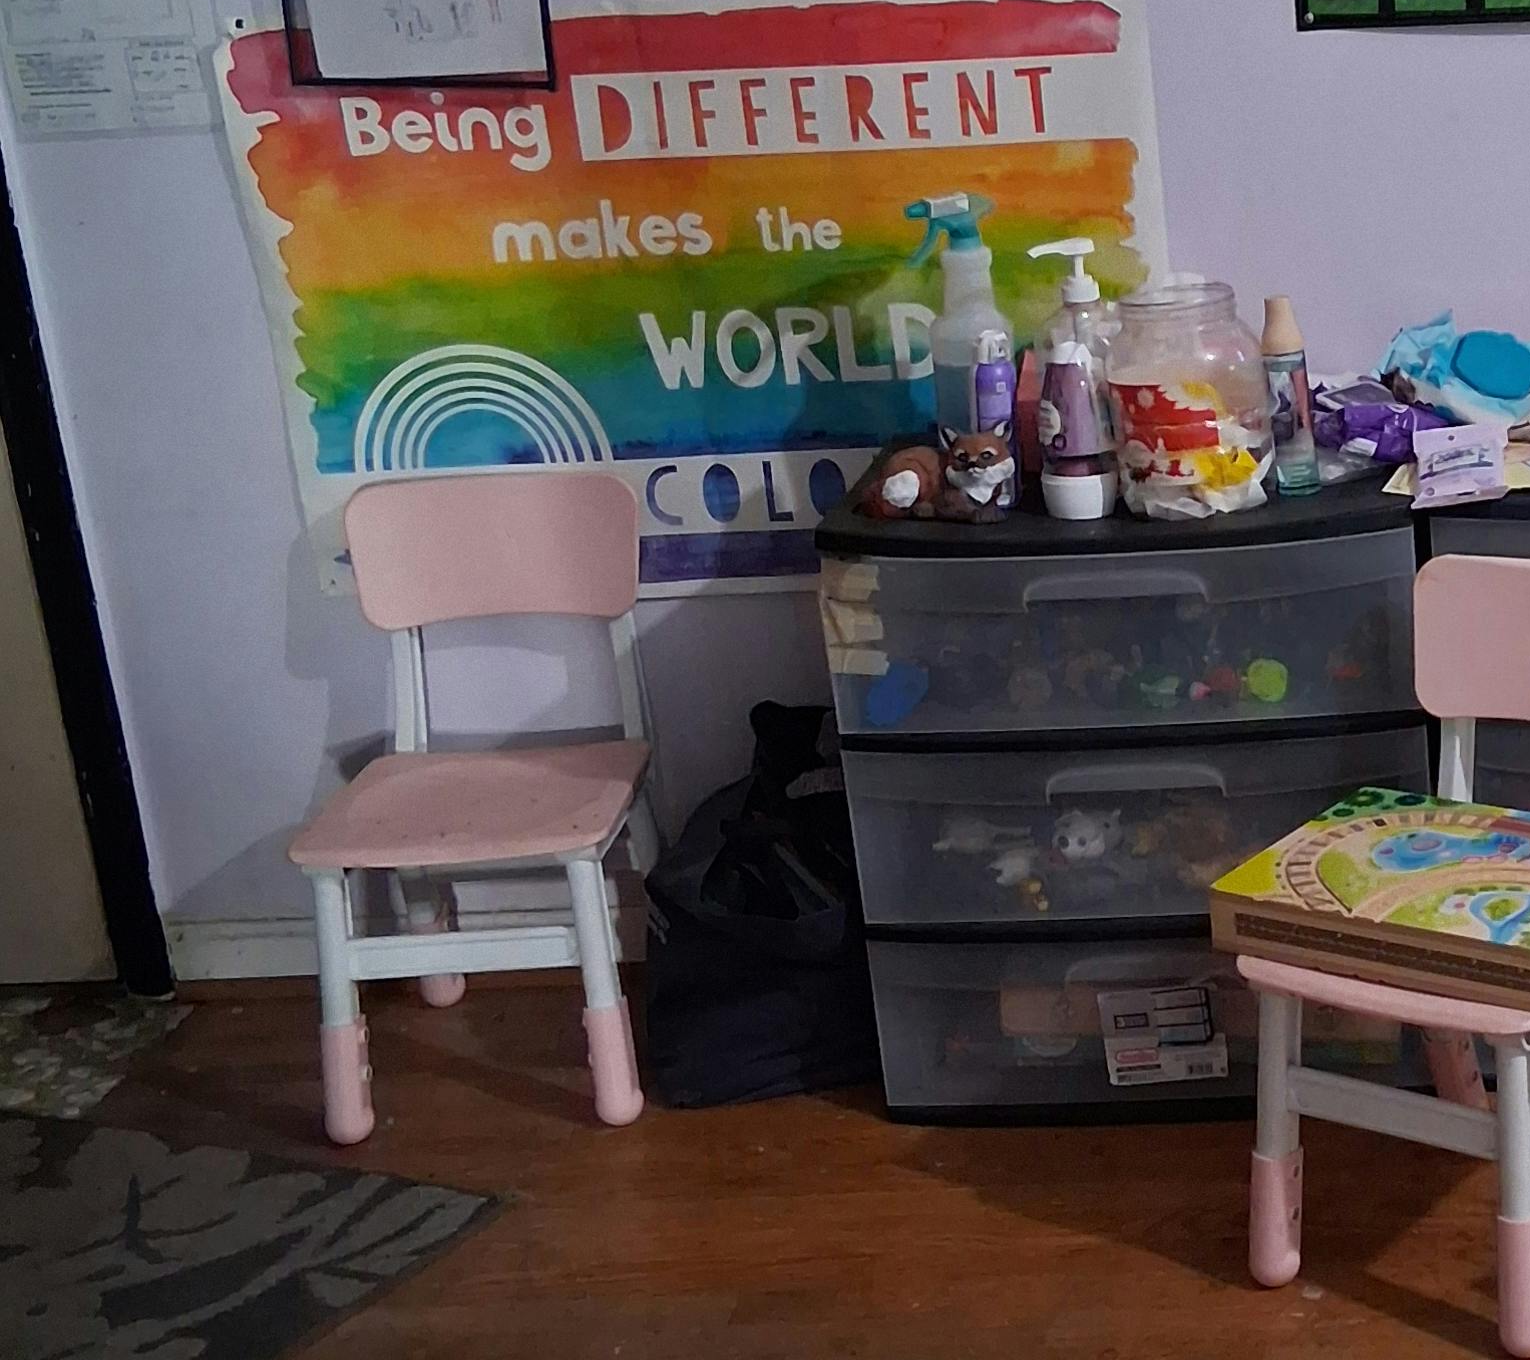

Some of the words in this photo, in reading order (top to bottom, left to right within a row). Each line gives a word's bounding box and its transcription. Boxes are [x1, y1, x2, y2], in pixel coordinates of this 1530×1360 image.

[338, 91, 553, 172] Being
[596, 66, 1053, 154] DIFFERENT
[491, 198, 713, 264] makes
[755, 205, 843, 253] the
[639, 301, 937, 390] WORLD
[645, 457, 847, 526] COLO
